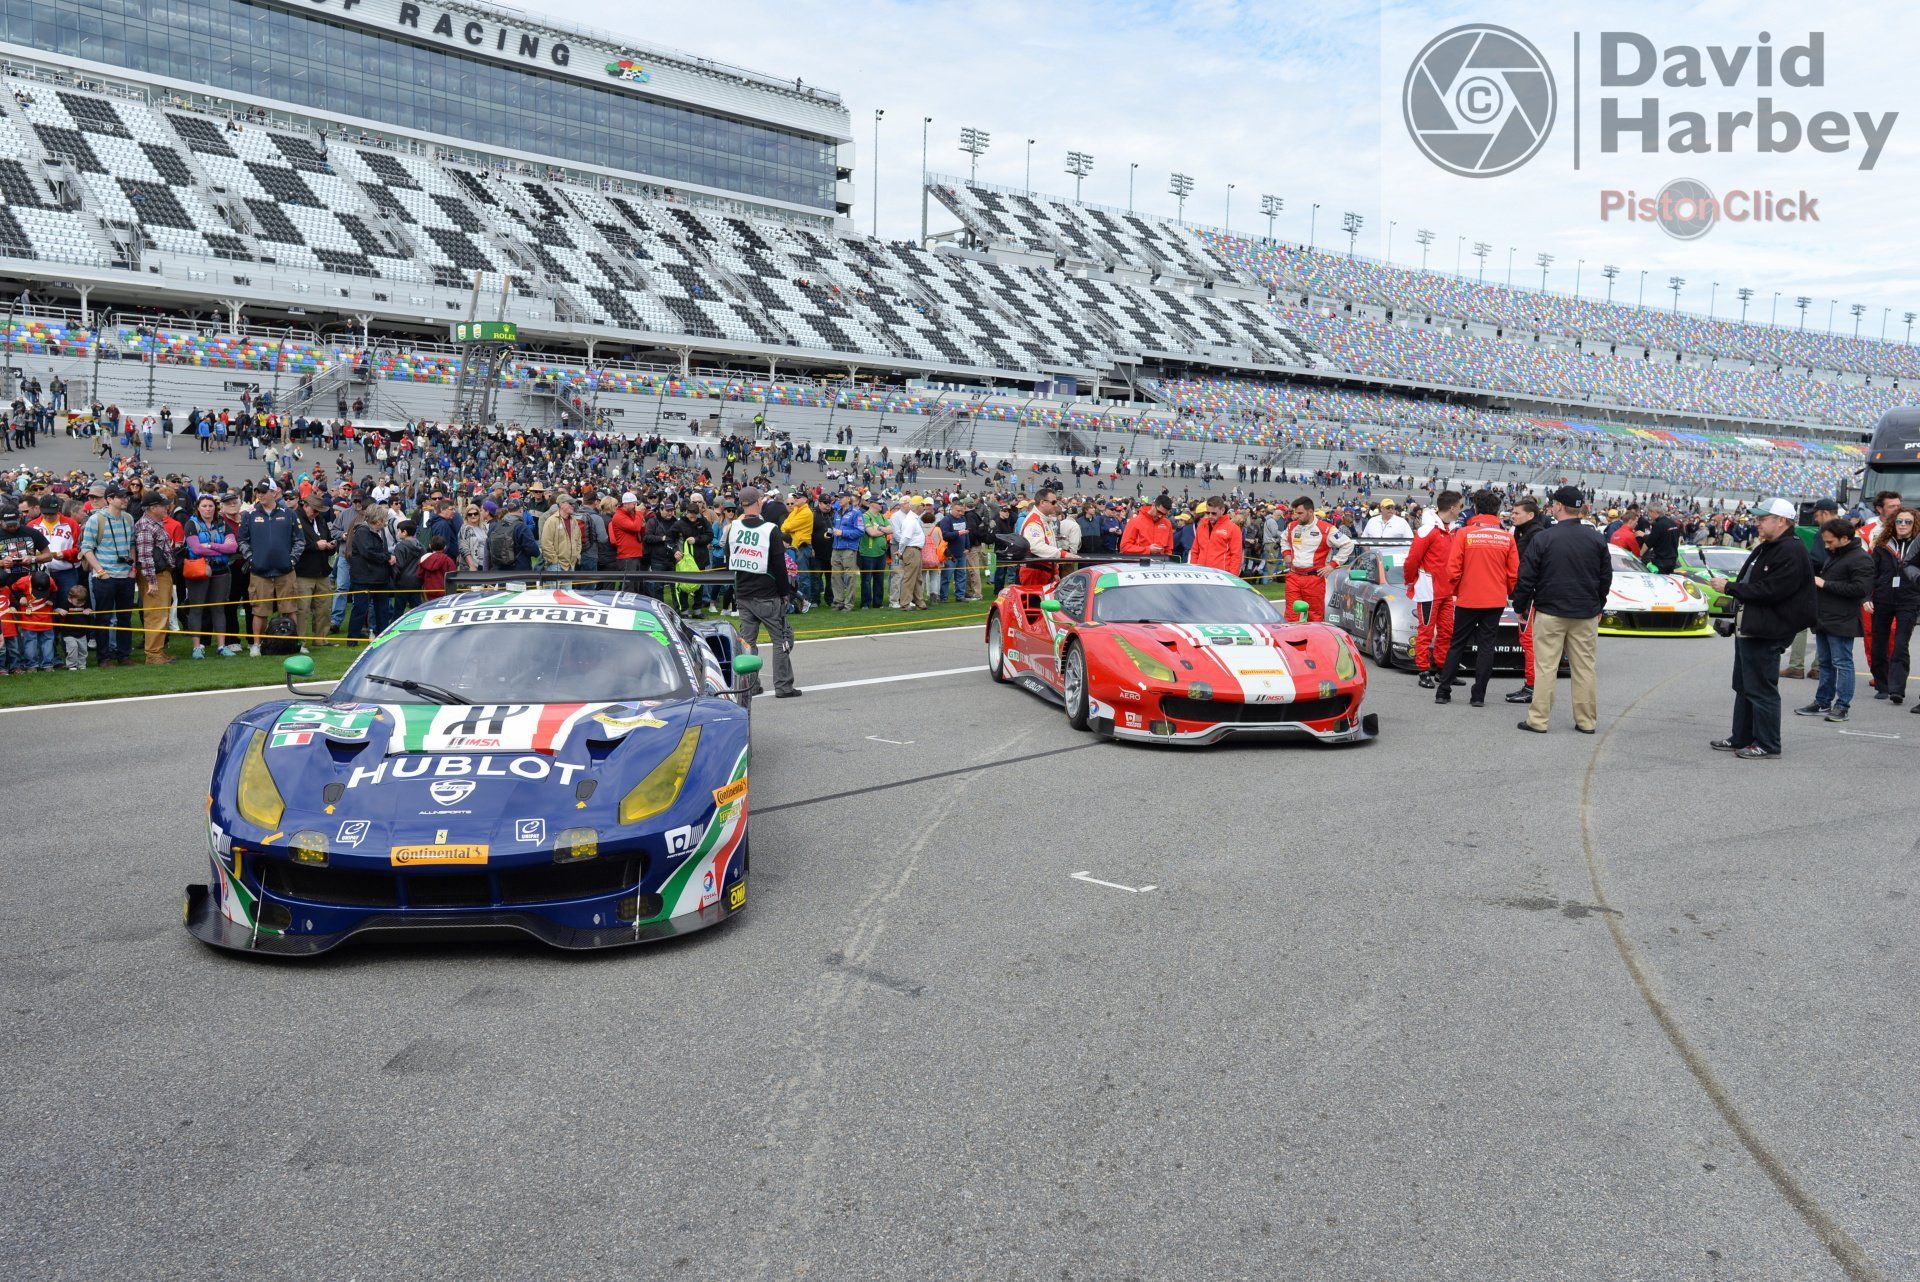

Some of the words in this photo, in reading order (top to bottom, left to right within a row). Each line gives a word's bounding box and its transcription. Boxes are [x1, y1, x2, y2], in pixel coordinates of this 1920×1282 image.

[399, 3, 571, 67] RACING
[493, 332, 516, 340] ROLEX
[735, 529, 760, 546] 289
[739, 547, 763, 558] IMSA
[730, 559, 759, 570] VIDEO
[1142, 572, 1211, 580] Ferrari
[447, 608, 609, 626] Ferrari
[1205, 626, 1241, 635] 63
[1119, 691, 1141, 701] AERO
[291, 708, 358, 729] 51
[465, 738, 501, 748] IMSA
[346, 755, 586, 789] HUBLOT
[396, 846, 471, 863] Continental
[703, 892, 717, 902] TOTAL
[730, 886, 746, 906] OMP
